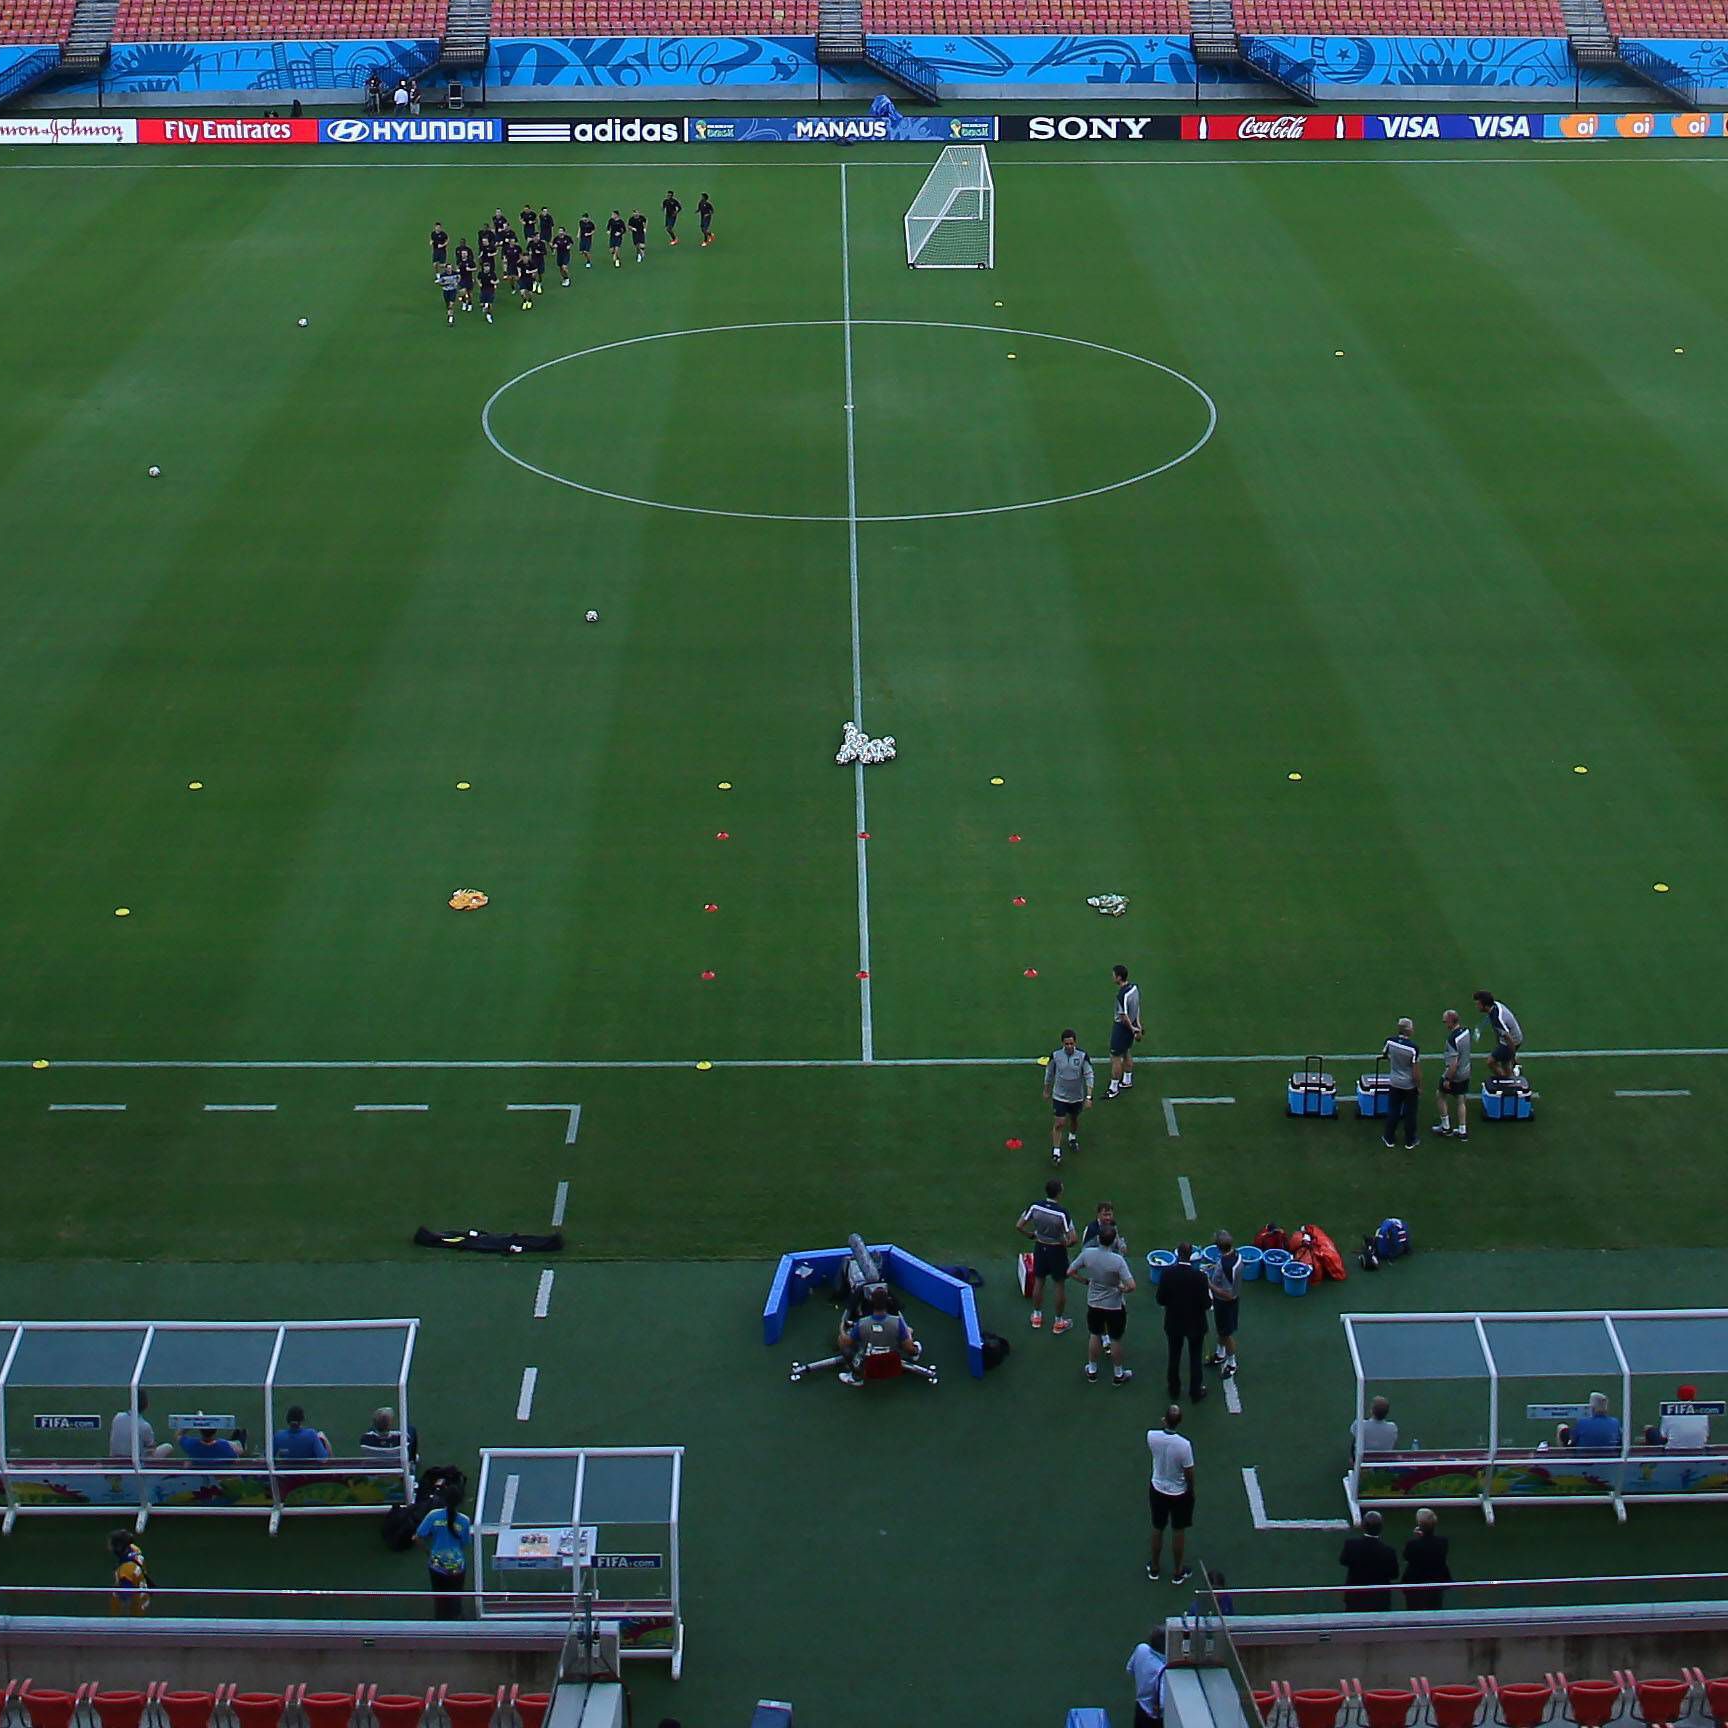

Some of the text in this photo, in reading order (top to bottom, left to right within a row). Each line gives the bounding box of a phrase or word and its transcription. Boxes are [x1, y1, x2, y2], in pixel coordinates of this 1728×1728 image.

[164, 120, 292, 143] Fly Emirates
[373, 121, 493, 140] HYUNDAI
[574, 118, 678, 142] adidas
[797, 121, 887, 138] MANAUS
[1029, 117, 1151, 140] SONY
[1378, 116, 1440, 138] VISA
[1469, 116, 1531, 137] VISA
[1577, 117, 1594, 135] oi
[1633, 116, 1650, 134] oi
[1688, 116, 1706, 133] oi
